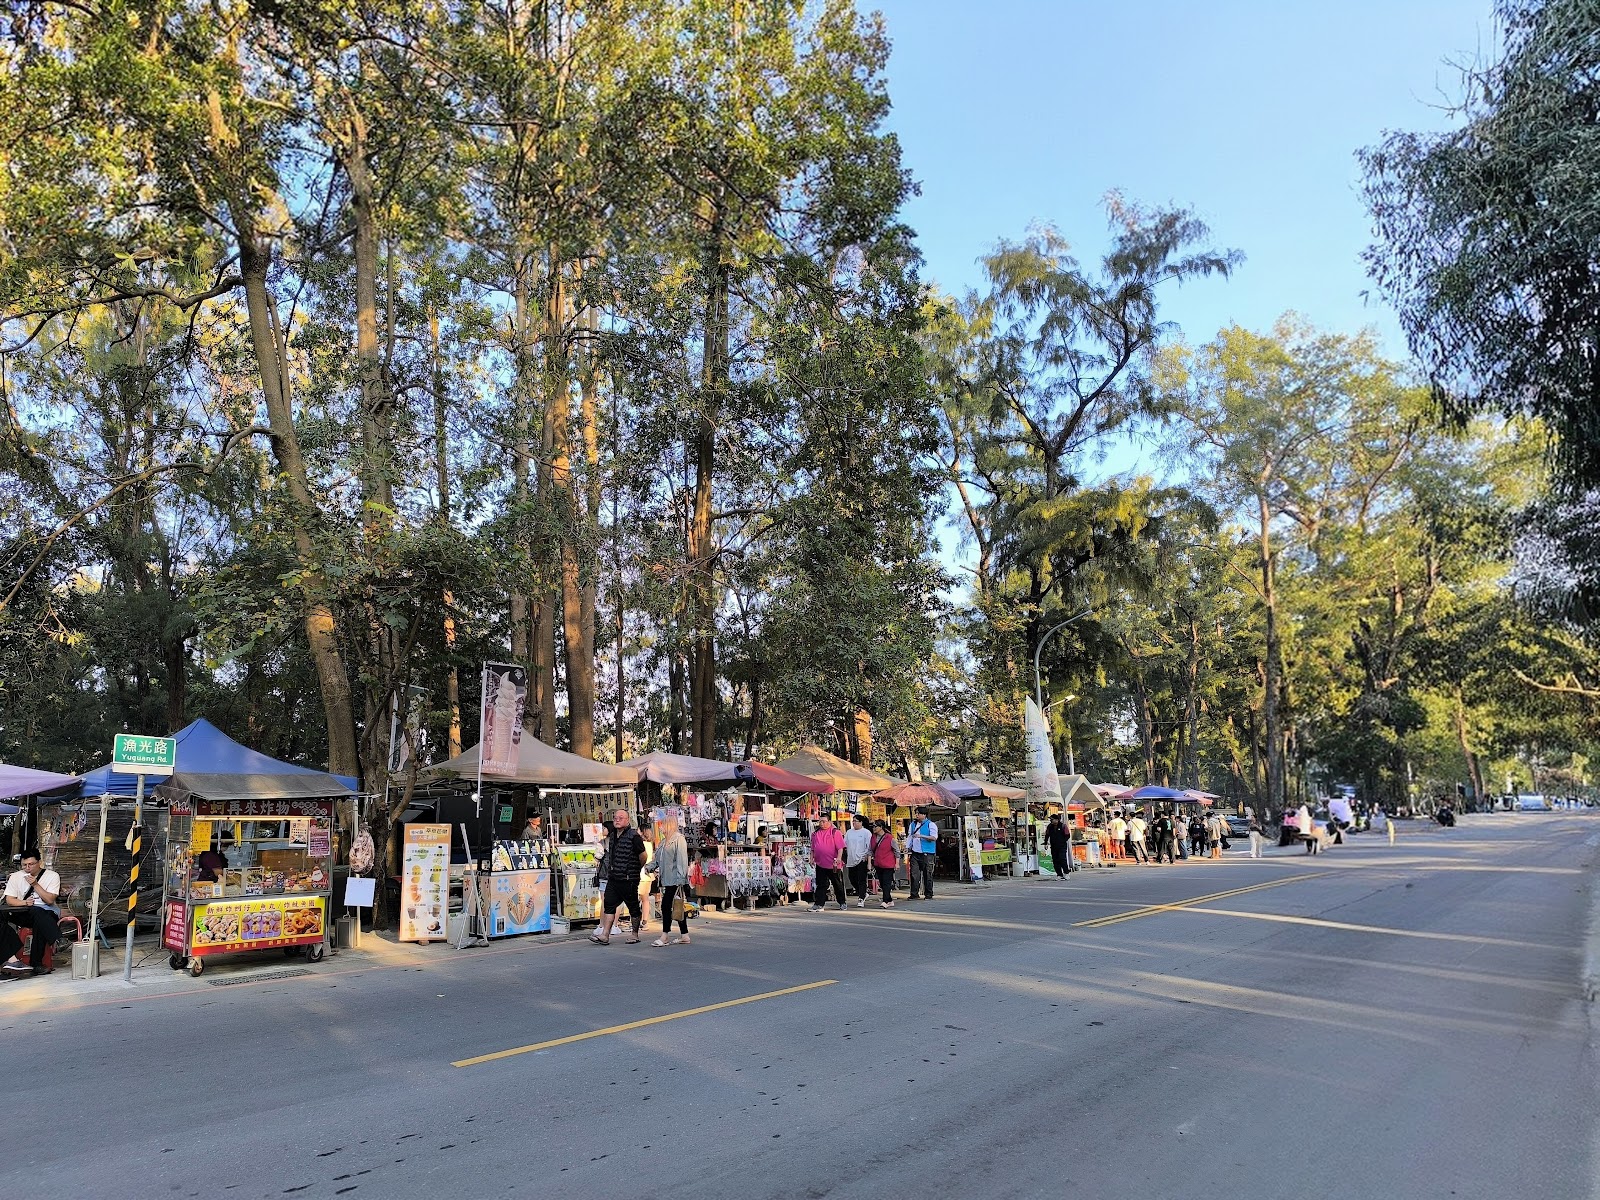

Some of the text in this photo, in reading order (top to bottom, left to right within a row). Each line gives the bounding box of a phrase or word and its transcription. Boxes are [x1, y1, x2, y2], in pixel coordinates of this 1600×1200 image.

[122, 738, 168, 754] 漁光路
[121, 754, 167, 763] Yuguang Rd.
